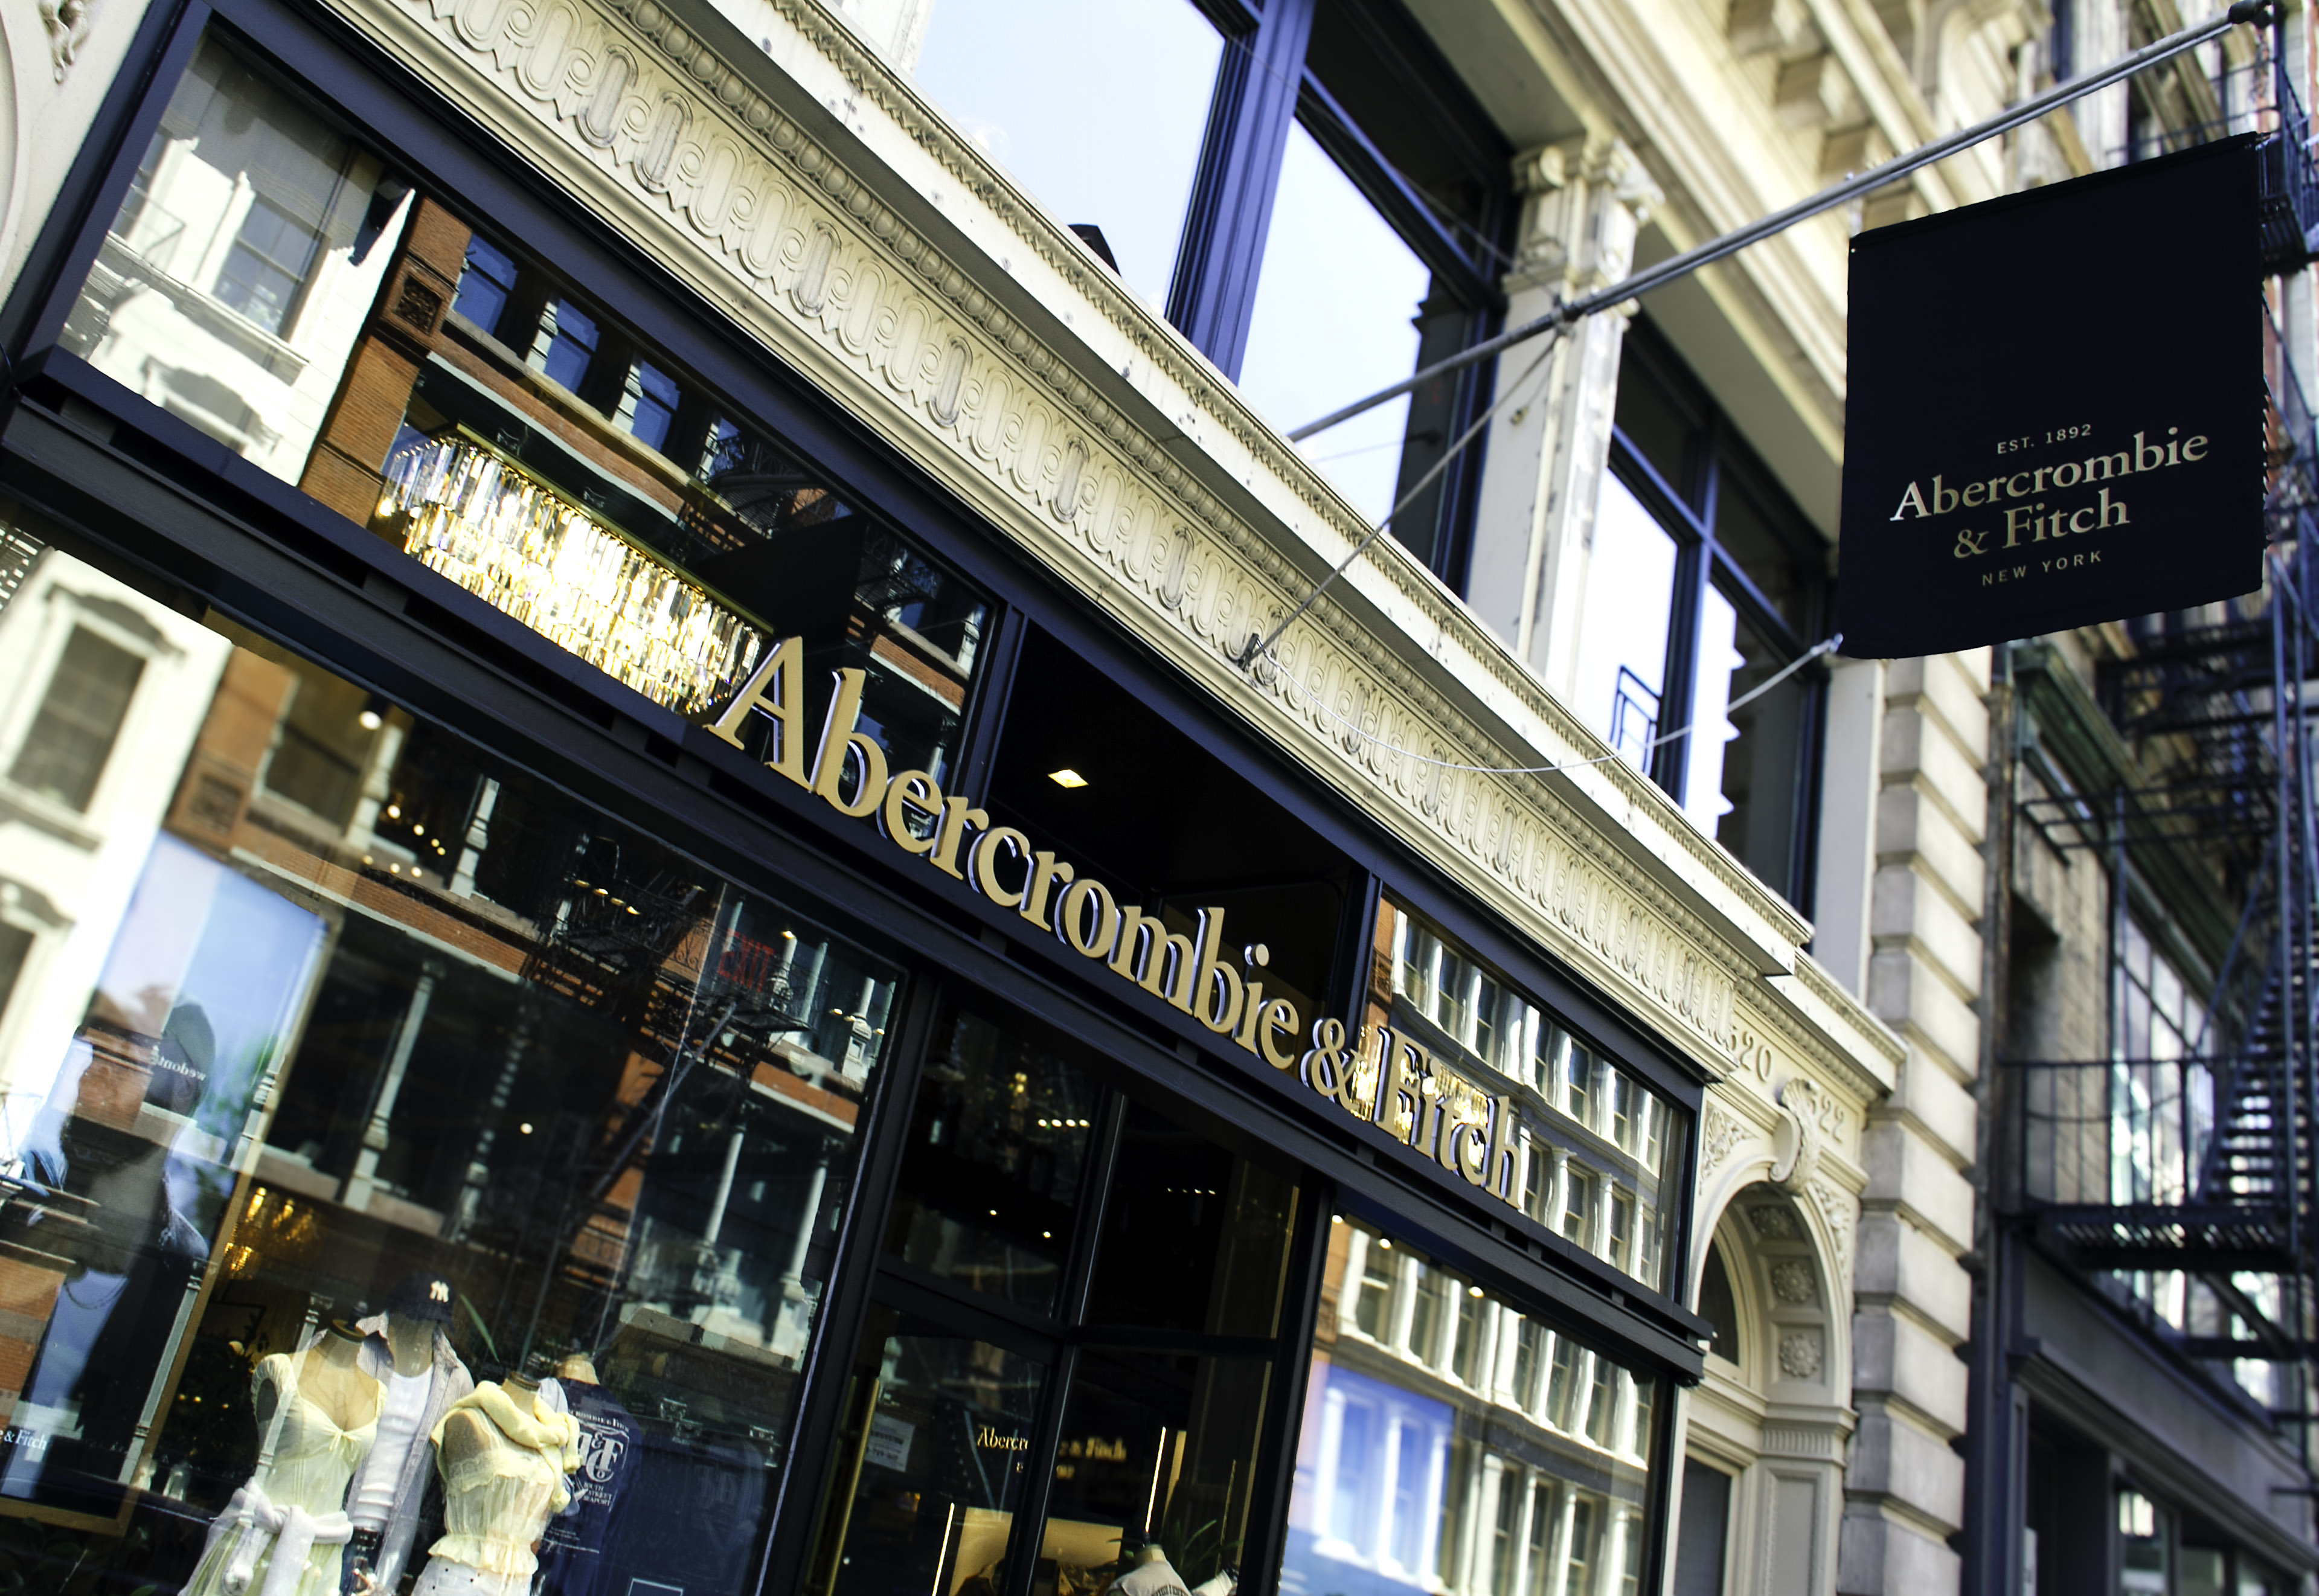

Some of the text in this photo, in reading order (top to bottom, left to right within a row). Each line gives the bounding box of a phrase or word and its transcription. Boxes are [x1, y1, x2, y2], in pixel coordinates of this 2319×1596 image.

[1997, 424, 2092, 455] EST. 1892
[1890, 426, 2208, 522] Abercrombie
[1953, 487, 2131, 559] & Fitch
[1982, 550, 2102, 586] NEW YORK
[703, 635, 1522, 1210] Abercrombie & Fitch
[717, 928, 775, 993] EXIT
[15, 1429, 47, 1450] Fitch
